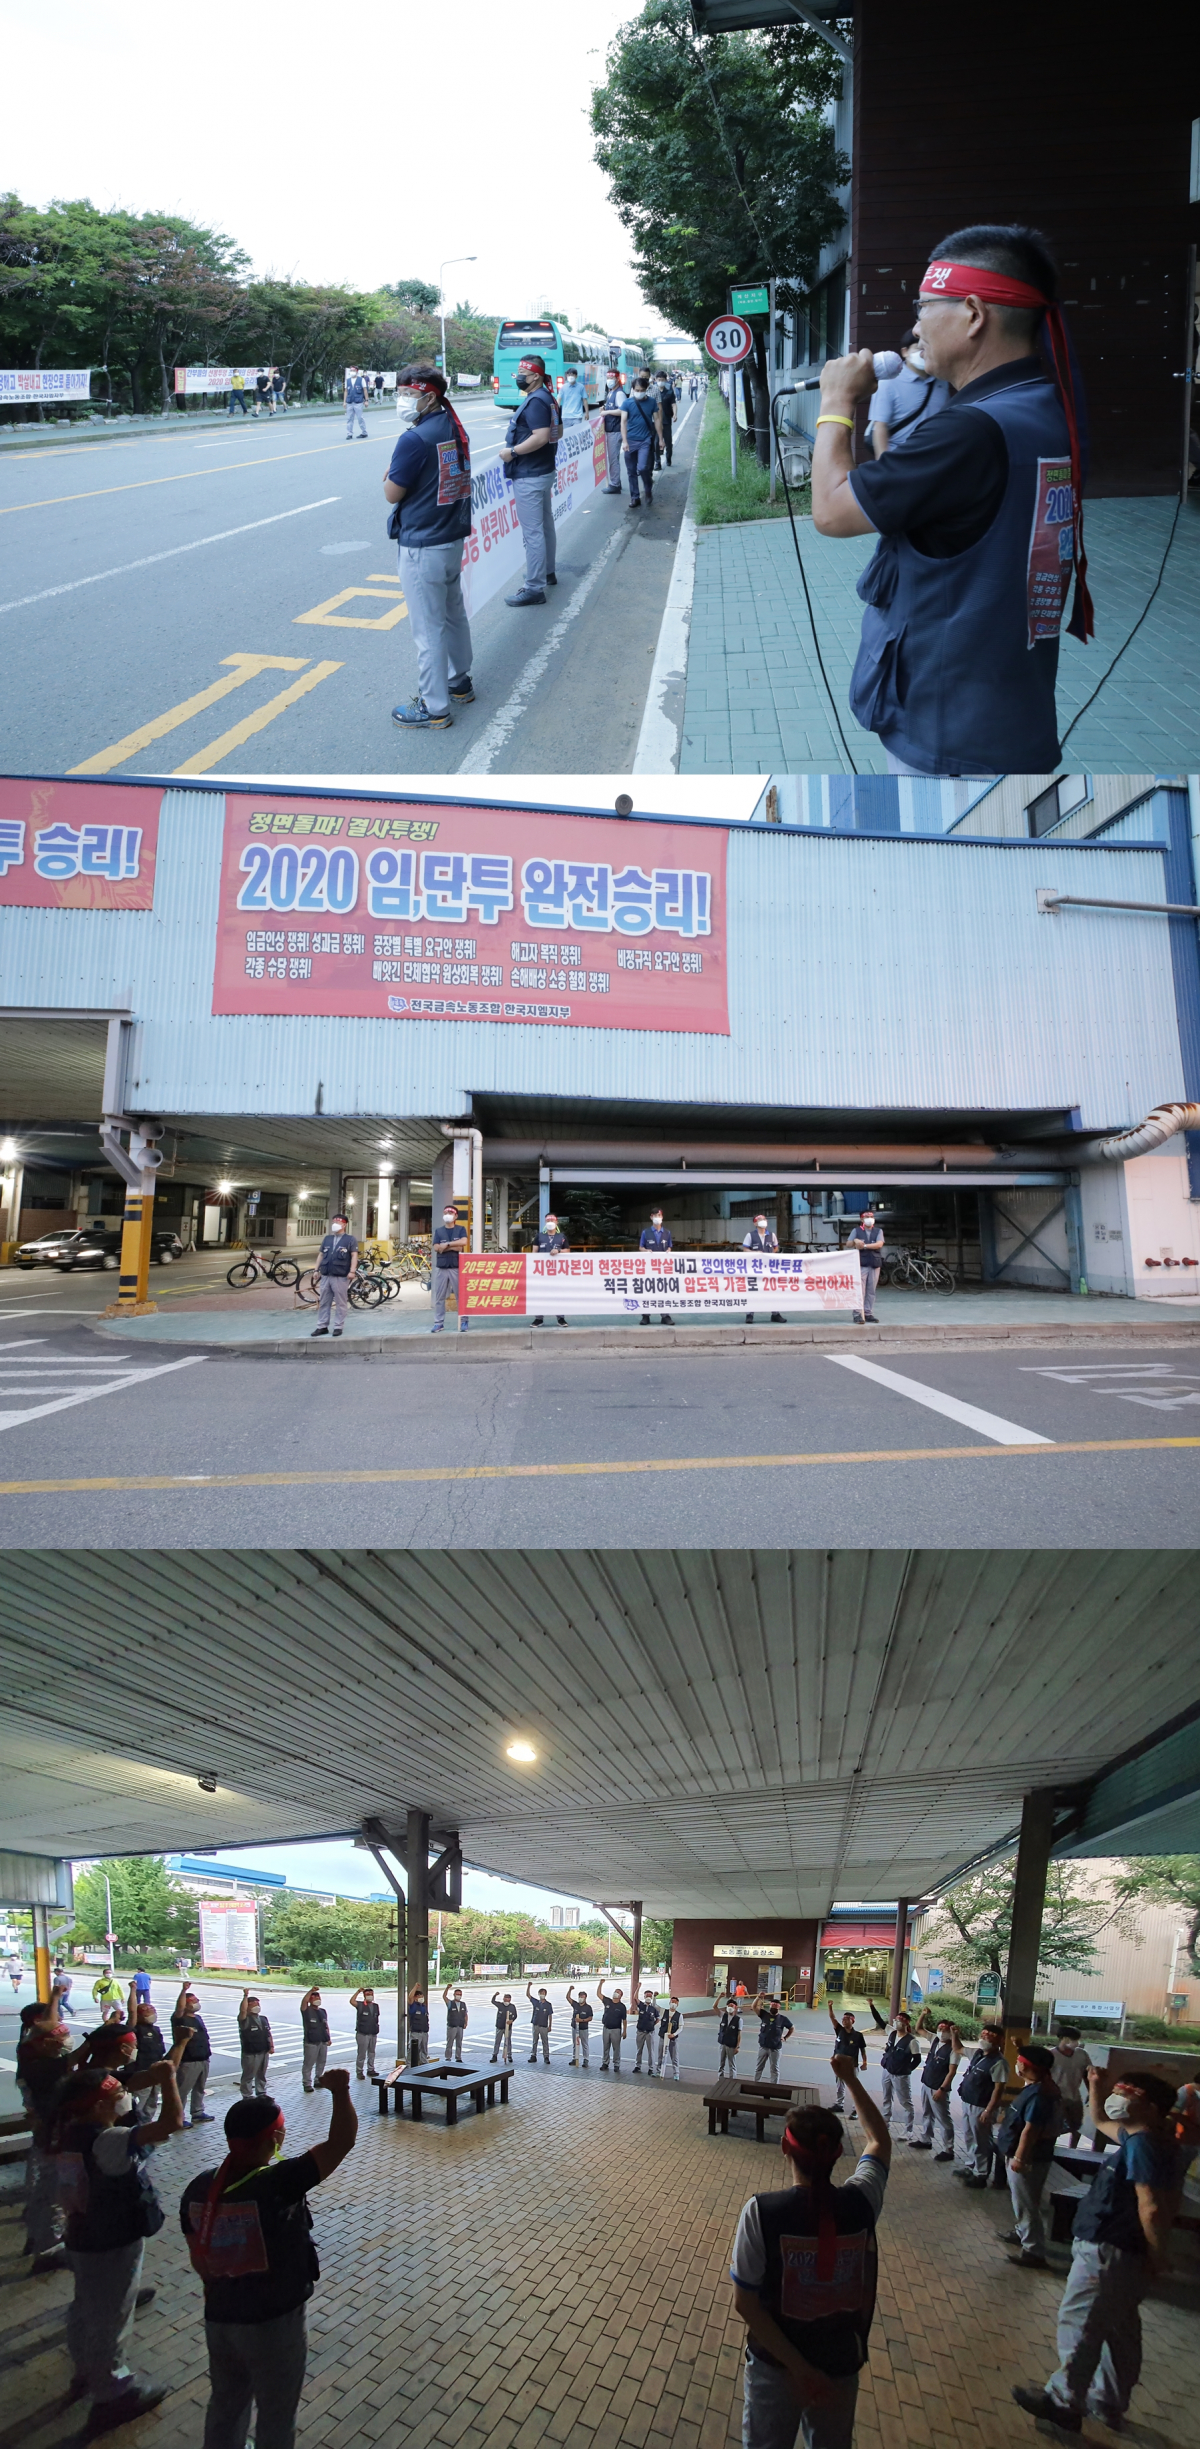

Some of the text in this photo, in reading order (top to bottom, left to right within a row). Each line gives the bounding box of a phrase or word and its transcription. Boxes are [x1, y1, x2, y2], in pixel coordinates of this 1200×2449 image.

[715, 328, 741, 349] 30
[249, 812, 440, 842] 정면돌파! 결사투쟁!
[34, 822, 143, 881] 승리!
[237, 843, 711, 938] 2020 임,단투 완전승리!
[246, 930, 365, 955] 임금인상 쟁취! 성과금 쟁취!
[373, 934, 477, 960] 공장별 특별 요구안 쟁취!
[510, 941, 582, 966] 해고자 복직 쟁취!
[245, 957, 312, 979] 각종 수당 쟁취!
[617, 949, 703, 974] 비정규직 요구안 쟁취!
[372, 960, 503, 987] 빼앗긴 단체협약 원상회복 쟁취!
[510, 967, 610, 993] 손해배상 소송 철회 쟁취!
[410, 999, 571, 1019] 전국금속노동조합 한국지엠지부
[462, 1260, 523, 1275] 20투쟁 승리!
[533, 1259, 594, 1276] 지엠자본의
[599, 1258, 646, 1275] 현장탄압
[651, 1258, 697, 1275] 박살내고
[701, 1258, 748, 1274] 쟁의행위
[466, 1279, 519, 1291] 정면돌파!
[604, 1275, 854, 1294] 적극 참여하여 압도적 가결로 20투쟁 승리하자!
[466, 1295, 519, 1308] 결사투쟁!
[642, 1299, 748, 1308] 전국금속노동조합 한국지엠지부
